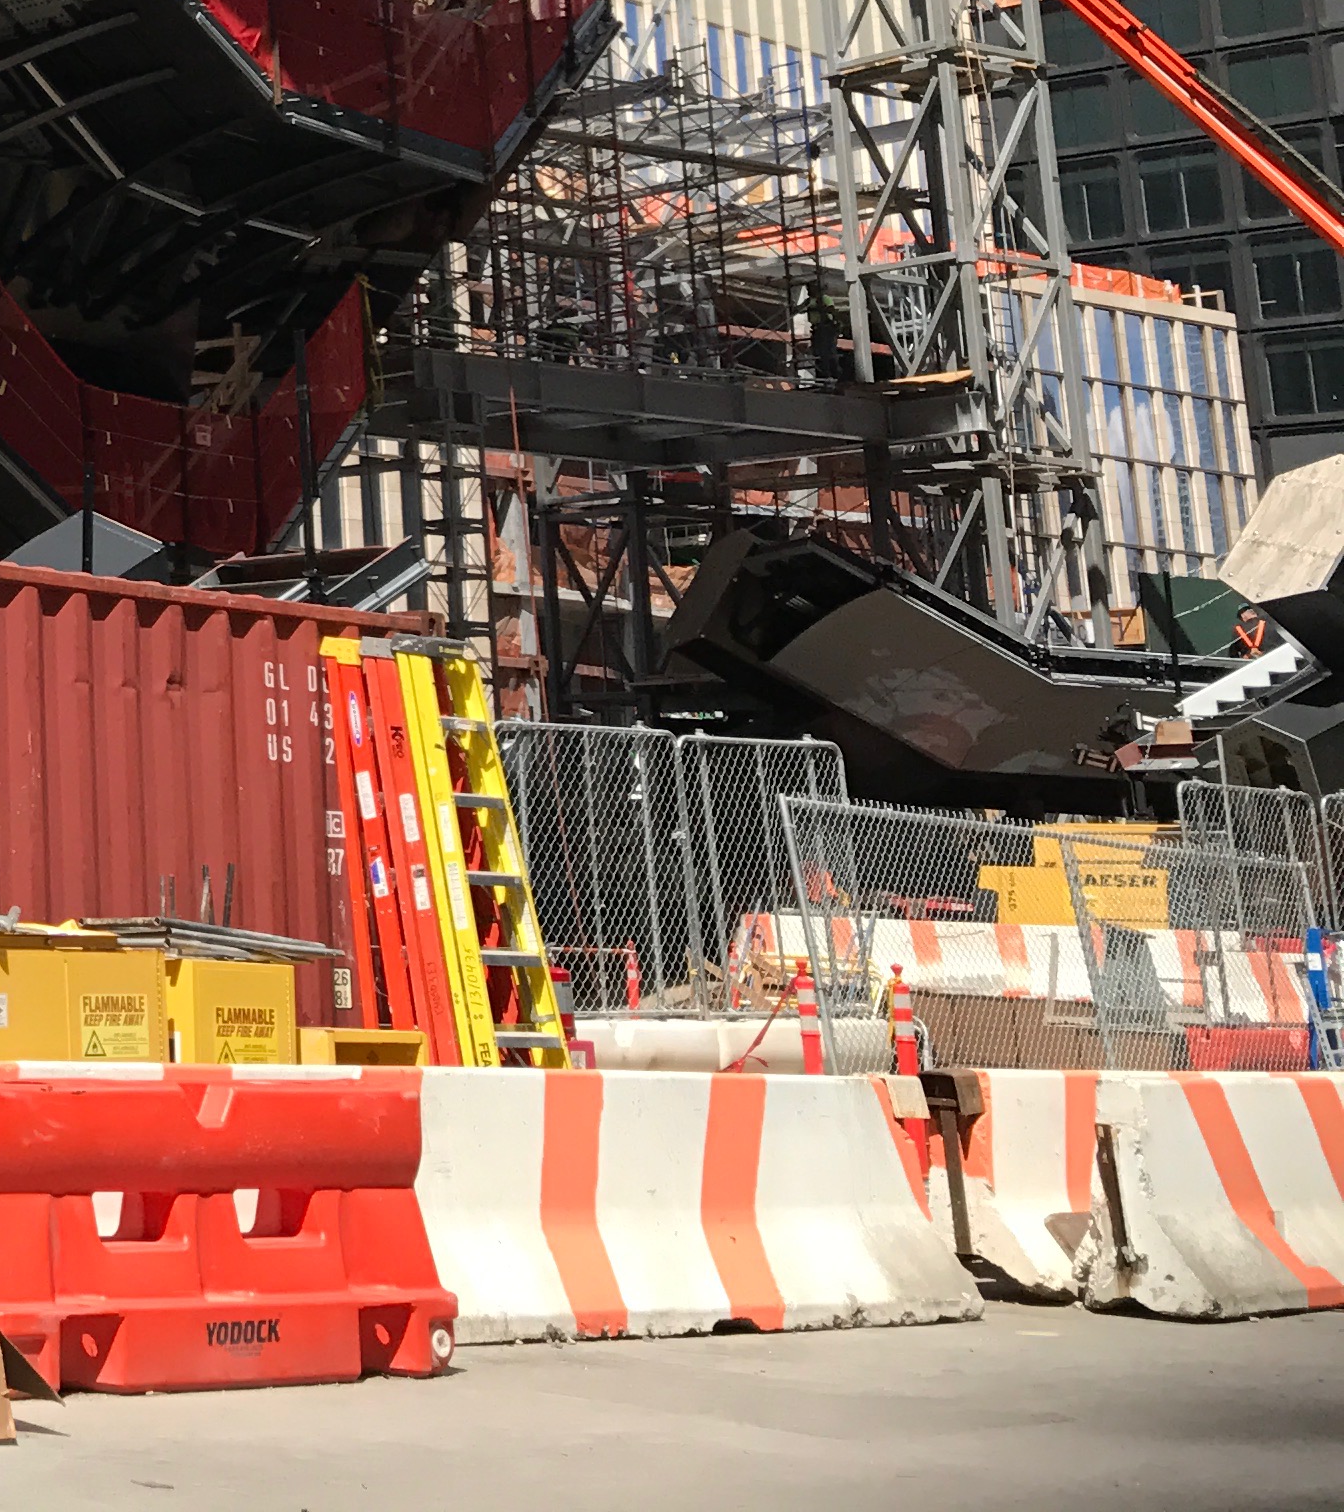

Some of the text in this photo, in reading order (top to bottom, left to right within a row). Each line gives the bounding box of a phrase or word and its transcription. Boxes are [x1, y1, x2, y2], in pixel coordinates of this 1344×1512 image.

[82, 995, 146, 1013] FLAMMABLE
[83, 1014, 145, 1027] KEEP FIRE AWAY
[215, 1007, 276, 1025] FLAMMABLE
[216, 1025, 276, 1038] KEEP FIRE AWAY
[206, 1318, 281, 1346] YODOCK
